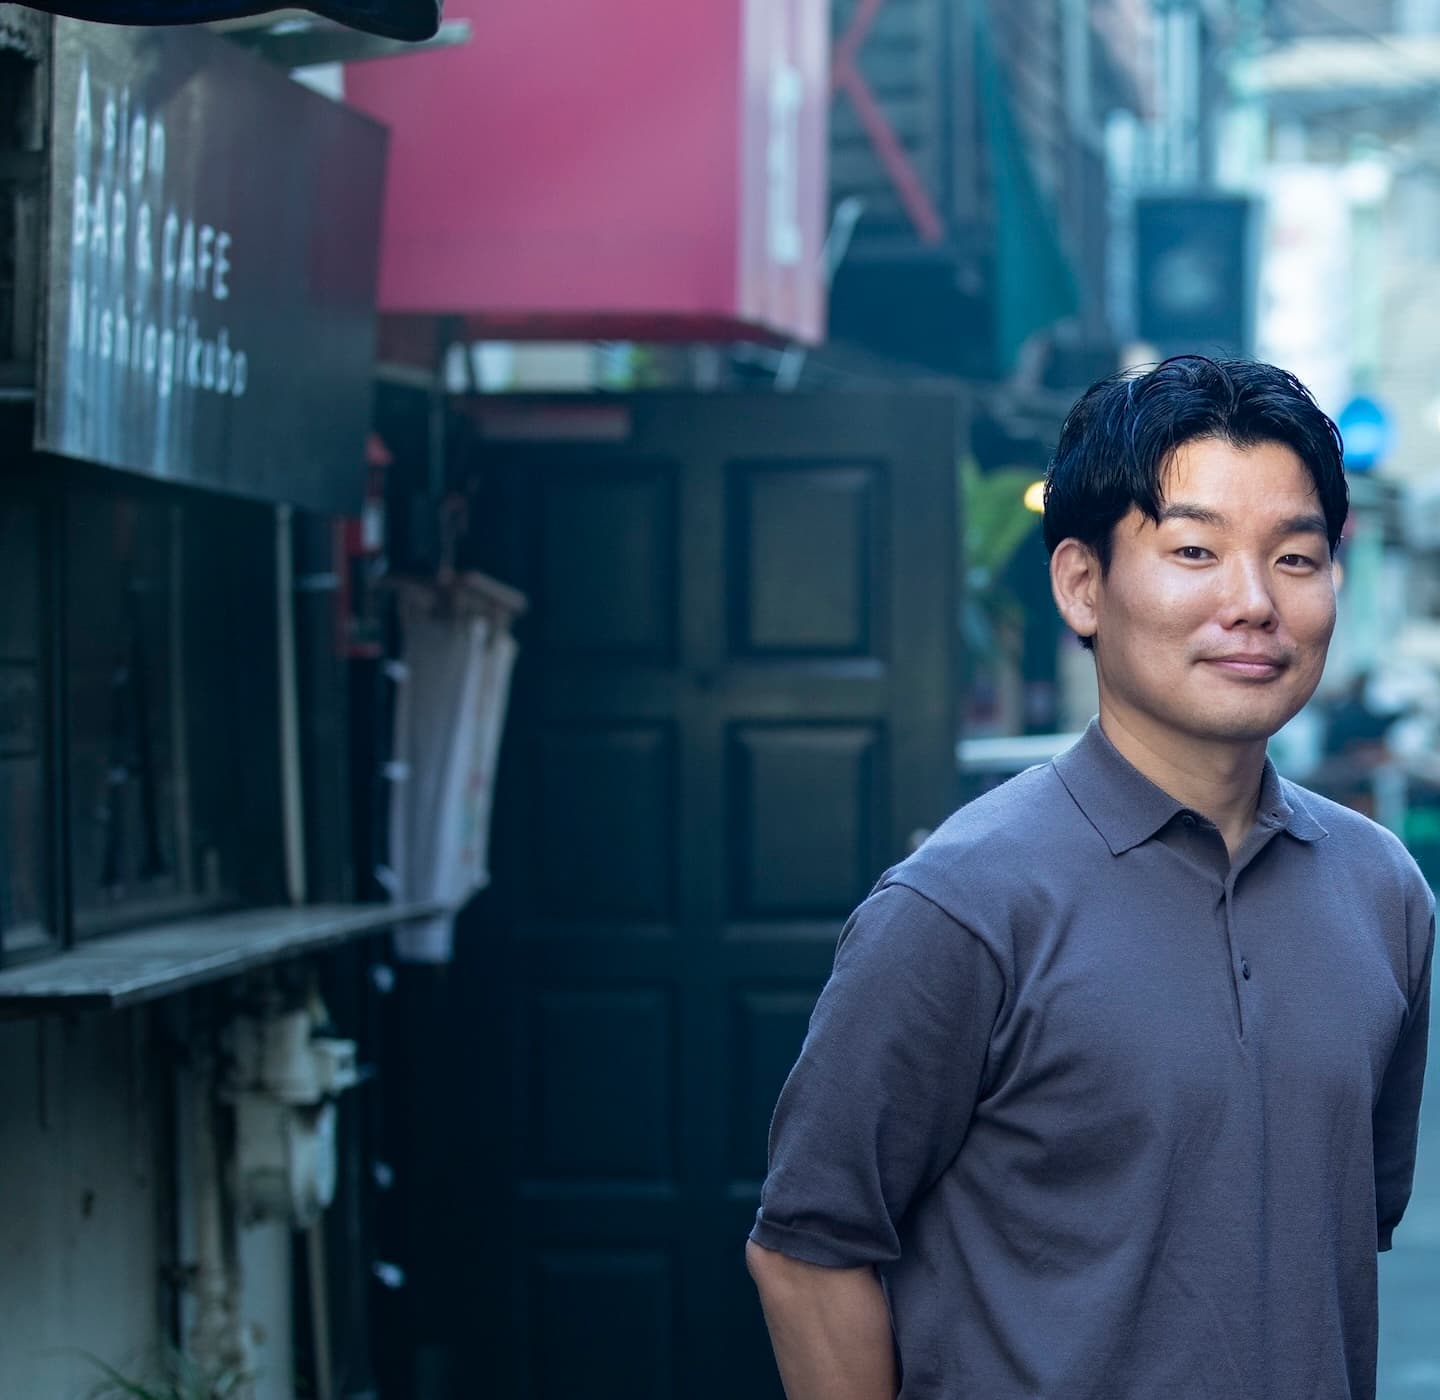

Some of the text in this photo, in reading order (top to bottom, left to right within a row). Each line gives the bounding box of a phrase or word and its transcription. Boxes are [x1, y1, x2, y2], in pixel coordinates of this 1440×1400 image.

[73, 62, 165, 184] Asian
[72, 174, 127, 262] BAR
[162, 210, 232, 300] CAFE
